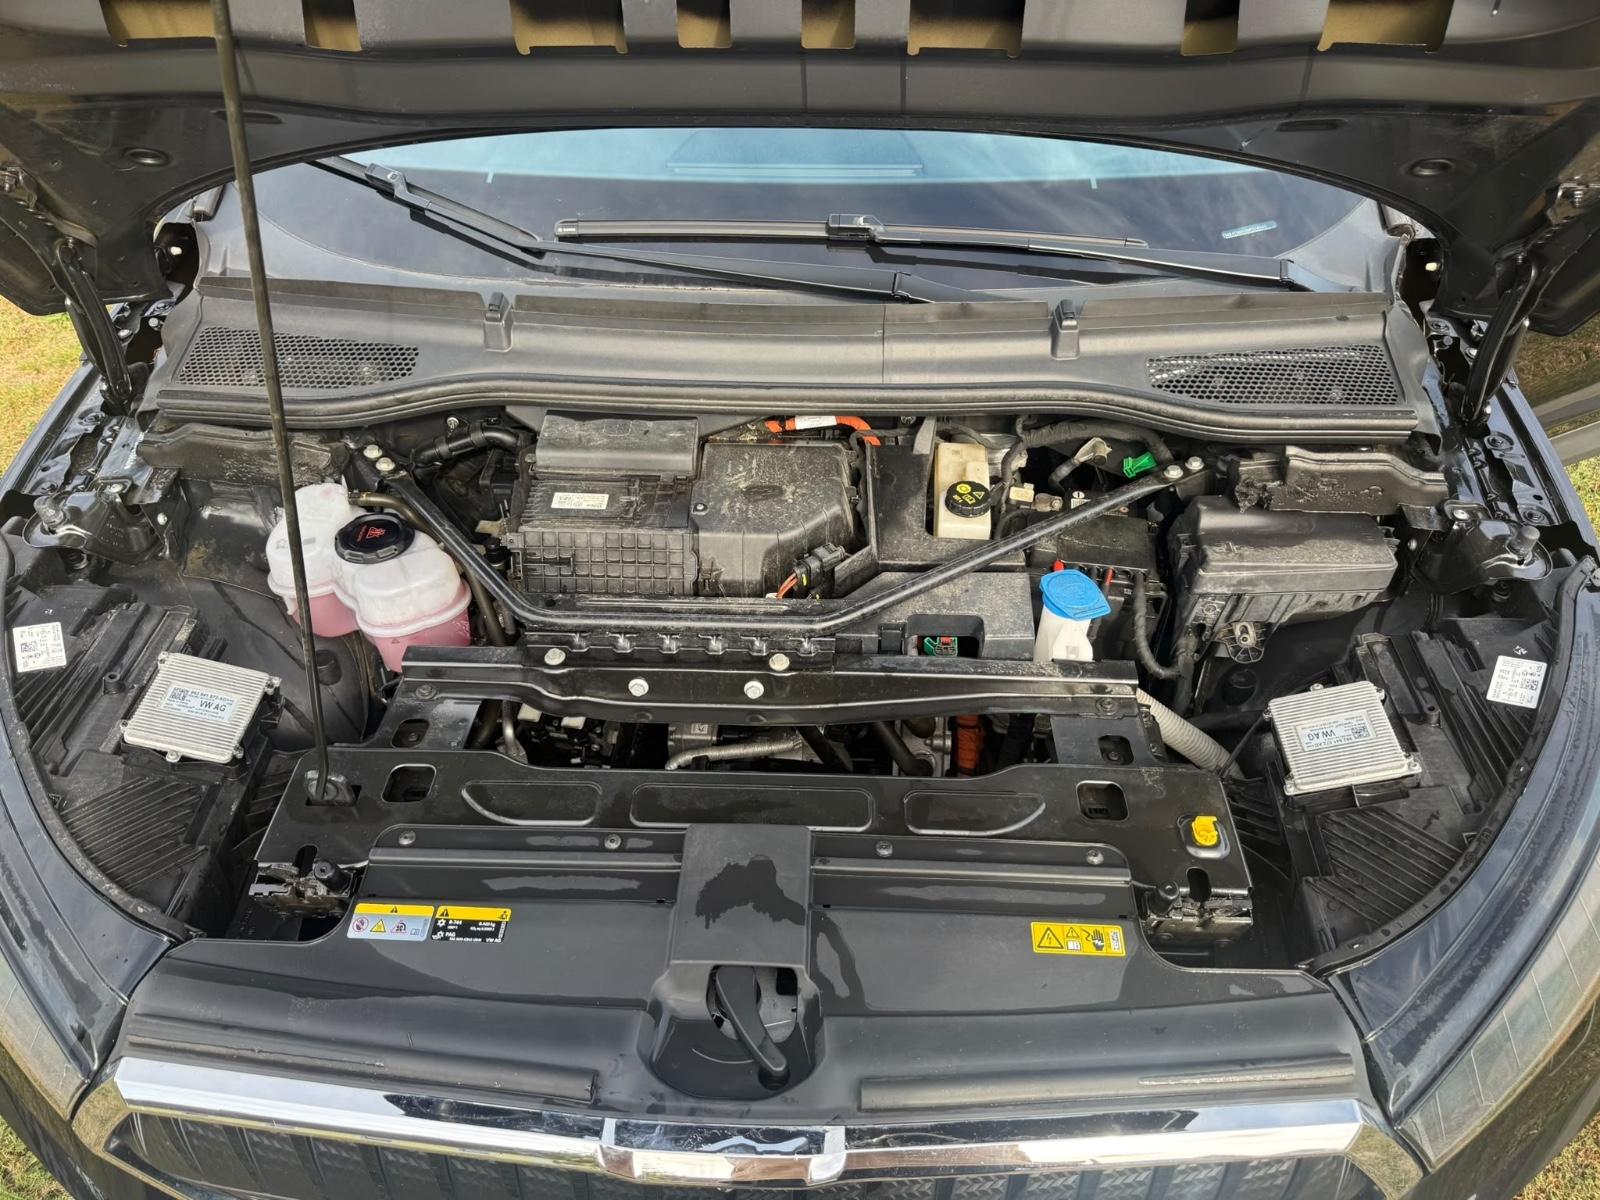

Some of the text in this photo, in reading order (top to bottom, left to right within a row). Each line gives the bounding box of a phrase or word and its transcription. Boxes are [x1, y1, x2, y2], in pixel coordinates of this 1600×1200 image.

[200, 700, 214, 709] VW
[213, 703, 227, 712] AG
[1307, 732, 1320, 741] AG
[1321, 729, 1336, 739] VW
